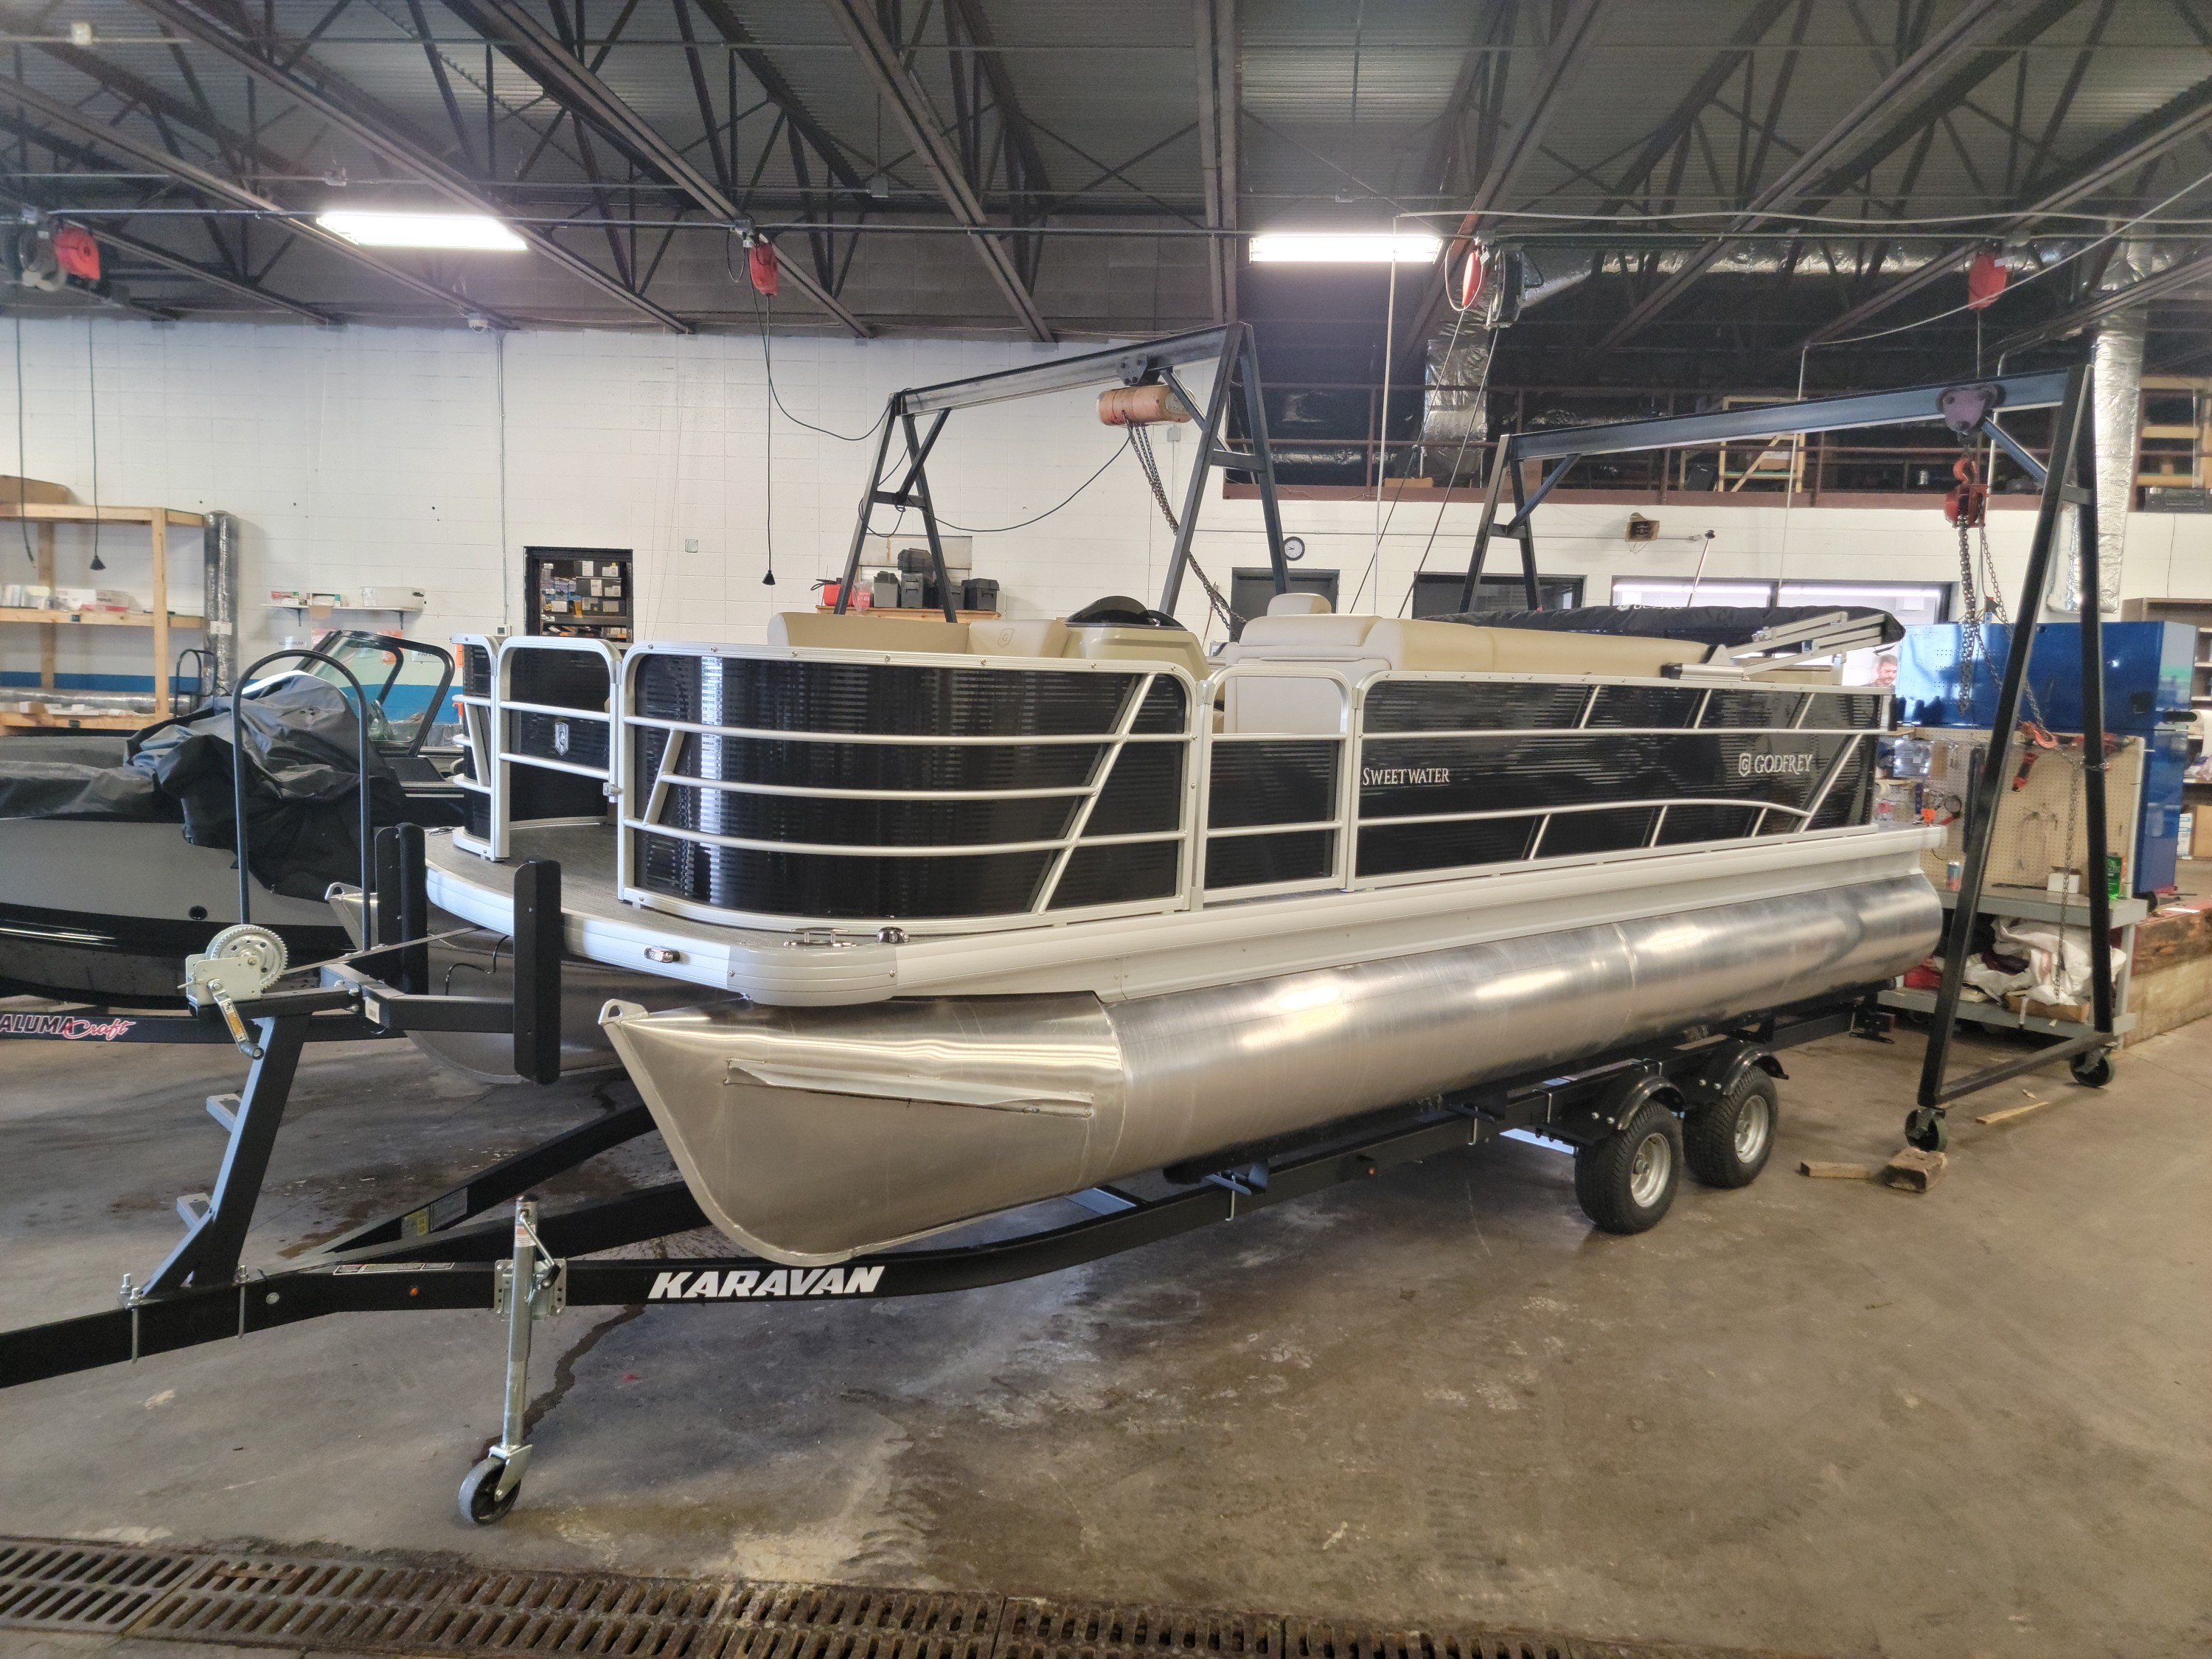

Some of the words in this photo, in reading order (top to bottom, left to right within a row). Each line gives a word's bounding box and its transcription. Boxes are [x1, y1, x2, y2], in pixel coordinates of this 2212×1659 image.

[1754, 754, 1813, 775] GODFREY
[1363, 768, 1450, 785] SWEETWATER
[647, 1266, 885, 1299] KARAVAN
